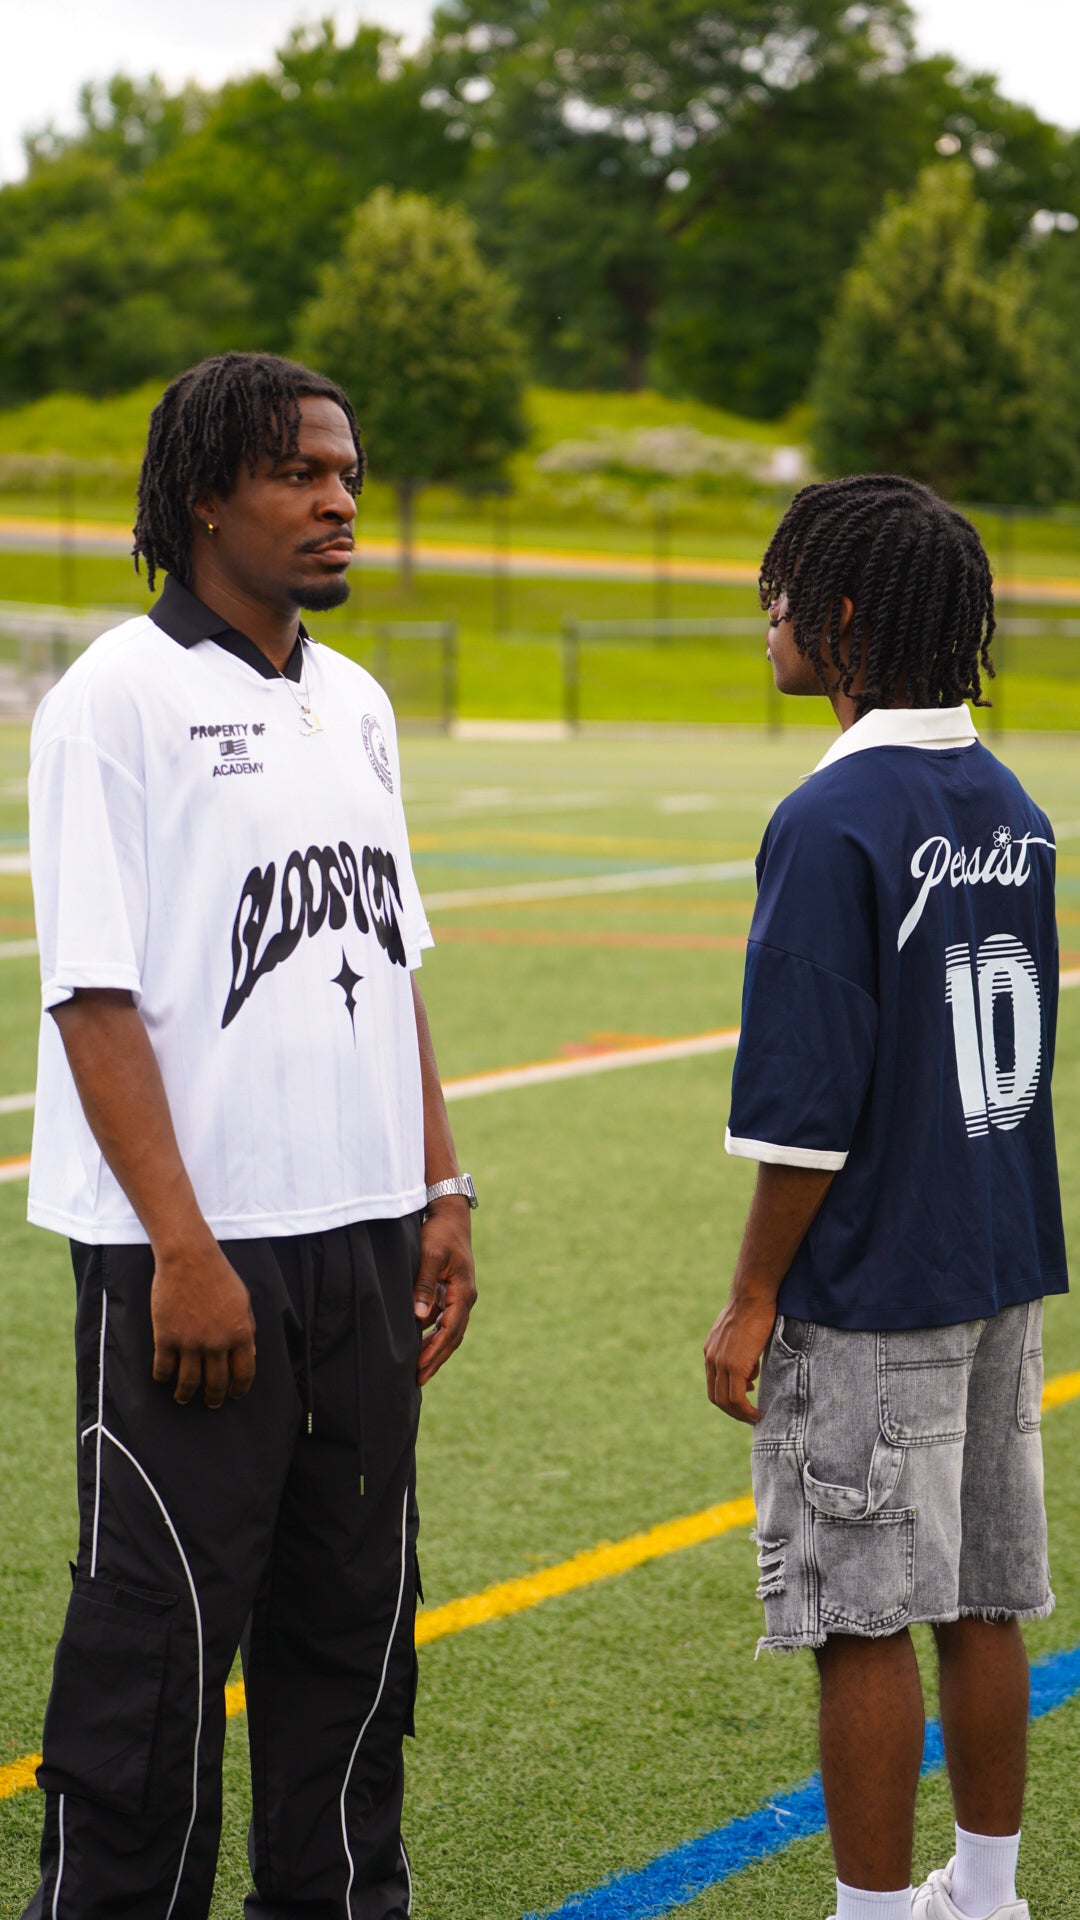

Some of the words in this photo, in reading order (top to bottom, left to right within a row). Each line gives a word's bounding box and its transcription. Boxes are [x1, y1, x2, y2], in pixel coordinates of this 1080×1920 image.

[190, 723, 248, 740] PROPERTY
[252, 723, 266, 736] OF
[212, 763, 264, 777] ACADEMY
[898, 826, 1055, 952] Persist
[945, 933, 1041, 1137] 10
